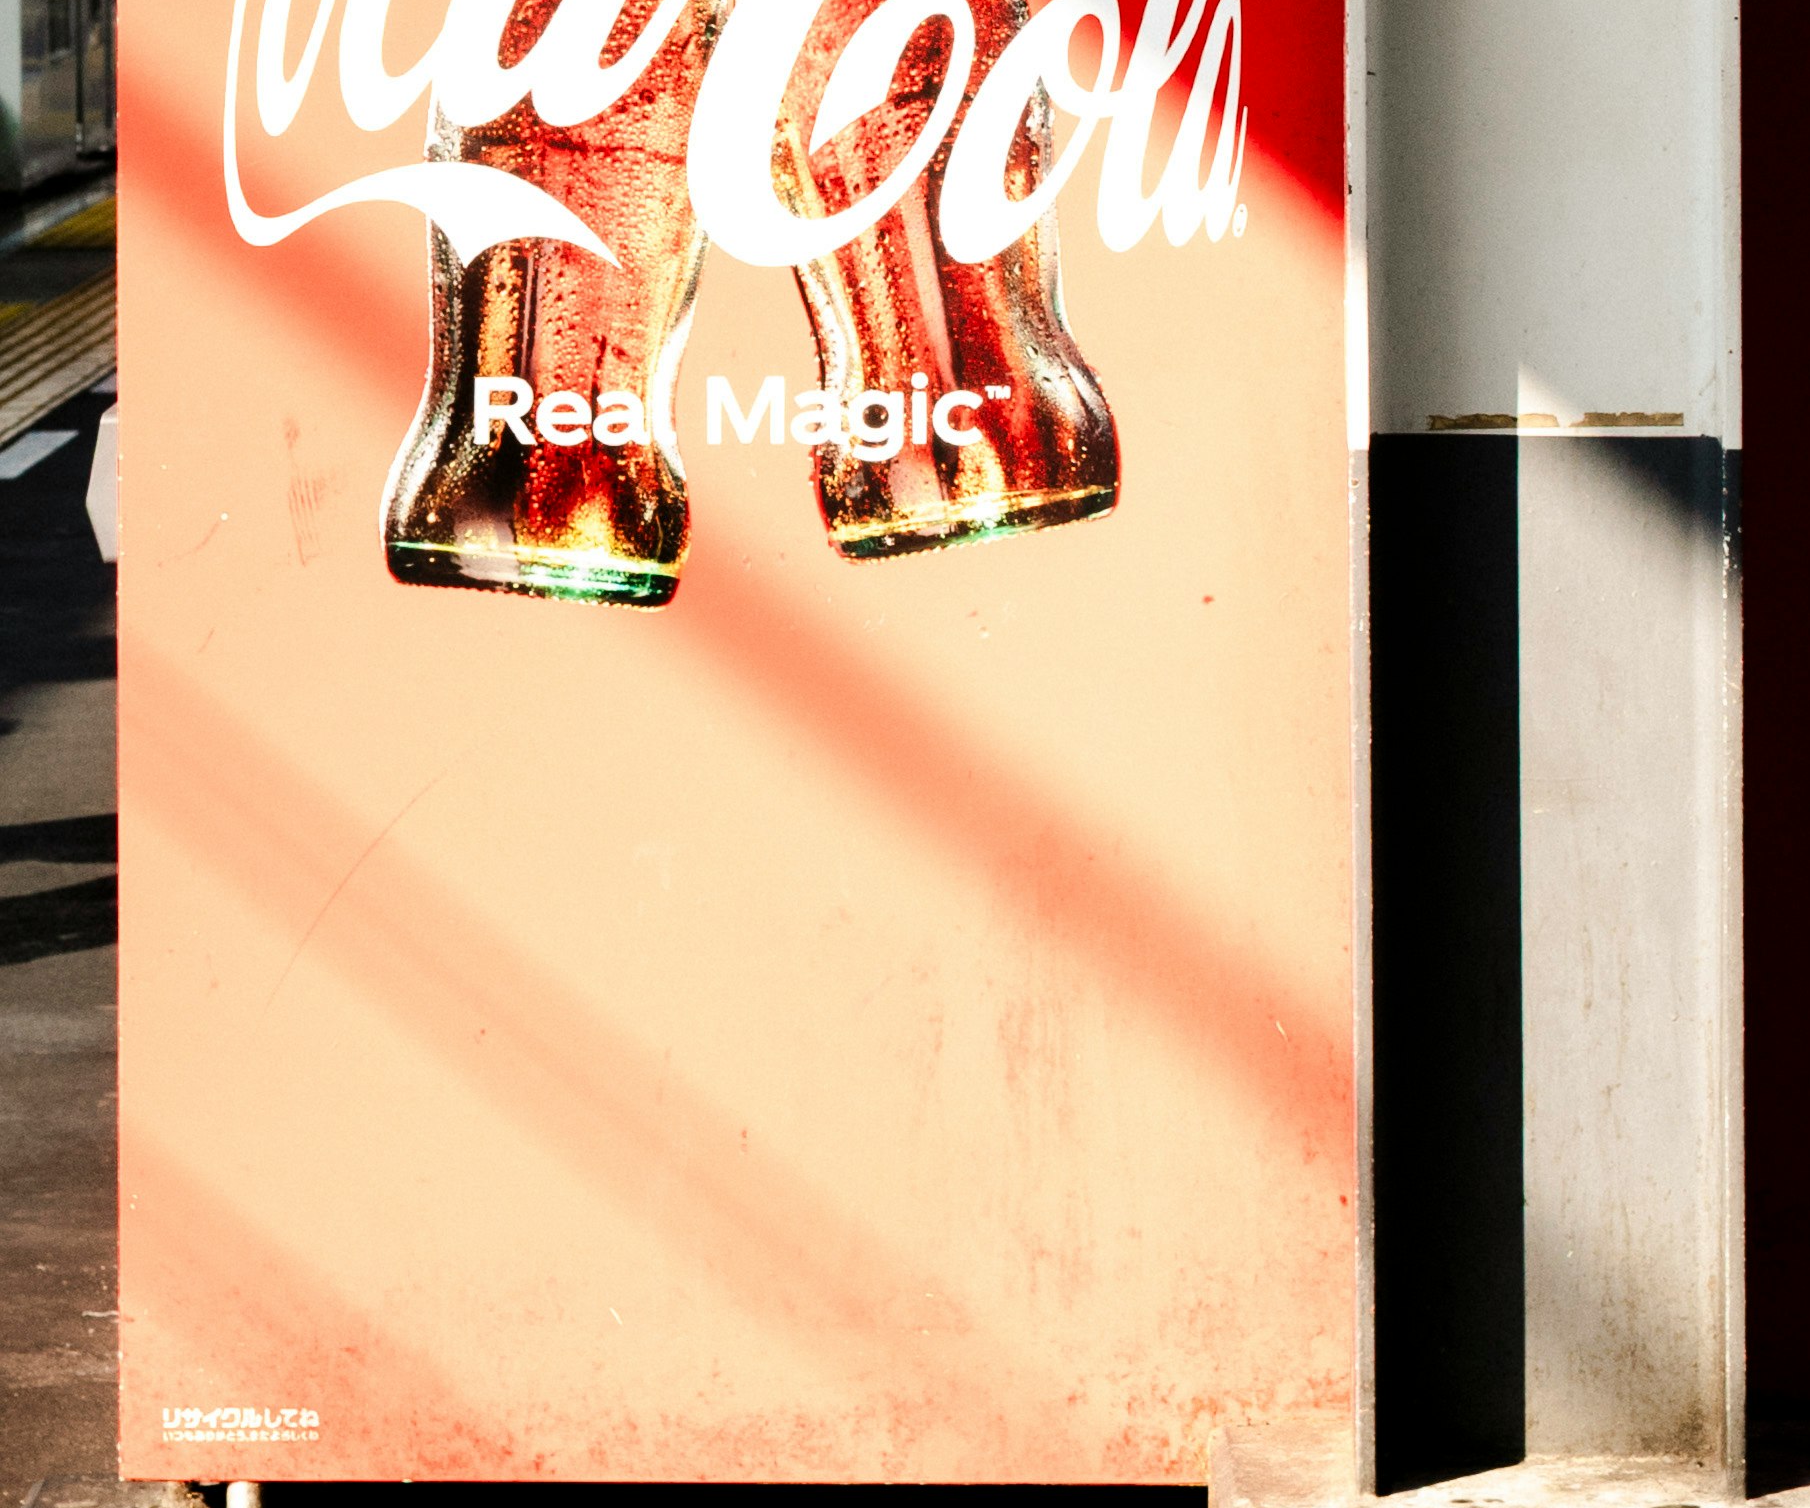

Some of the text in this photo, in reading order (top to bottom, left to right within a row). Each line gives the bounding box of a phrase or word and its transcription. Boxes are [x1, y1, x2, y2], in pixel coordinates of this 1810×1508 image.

[472, 372, 677, 447] Real
[162, 1407, 320, 1429] リサイクルしてね
